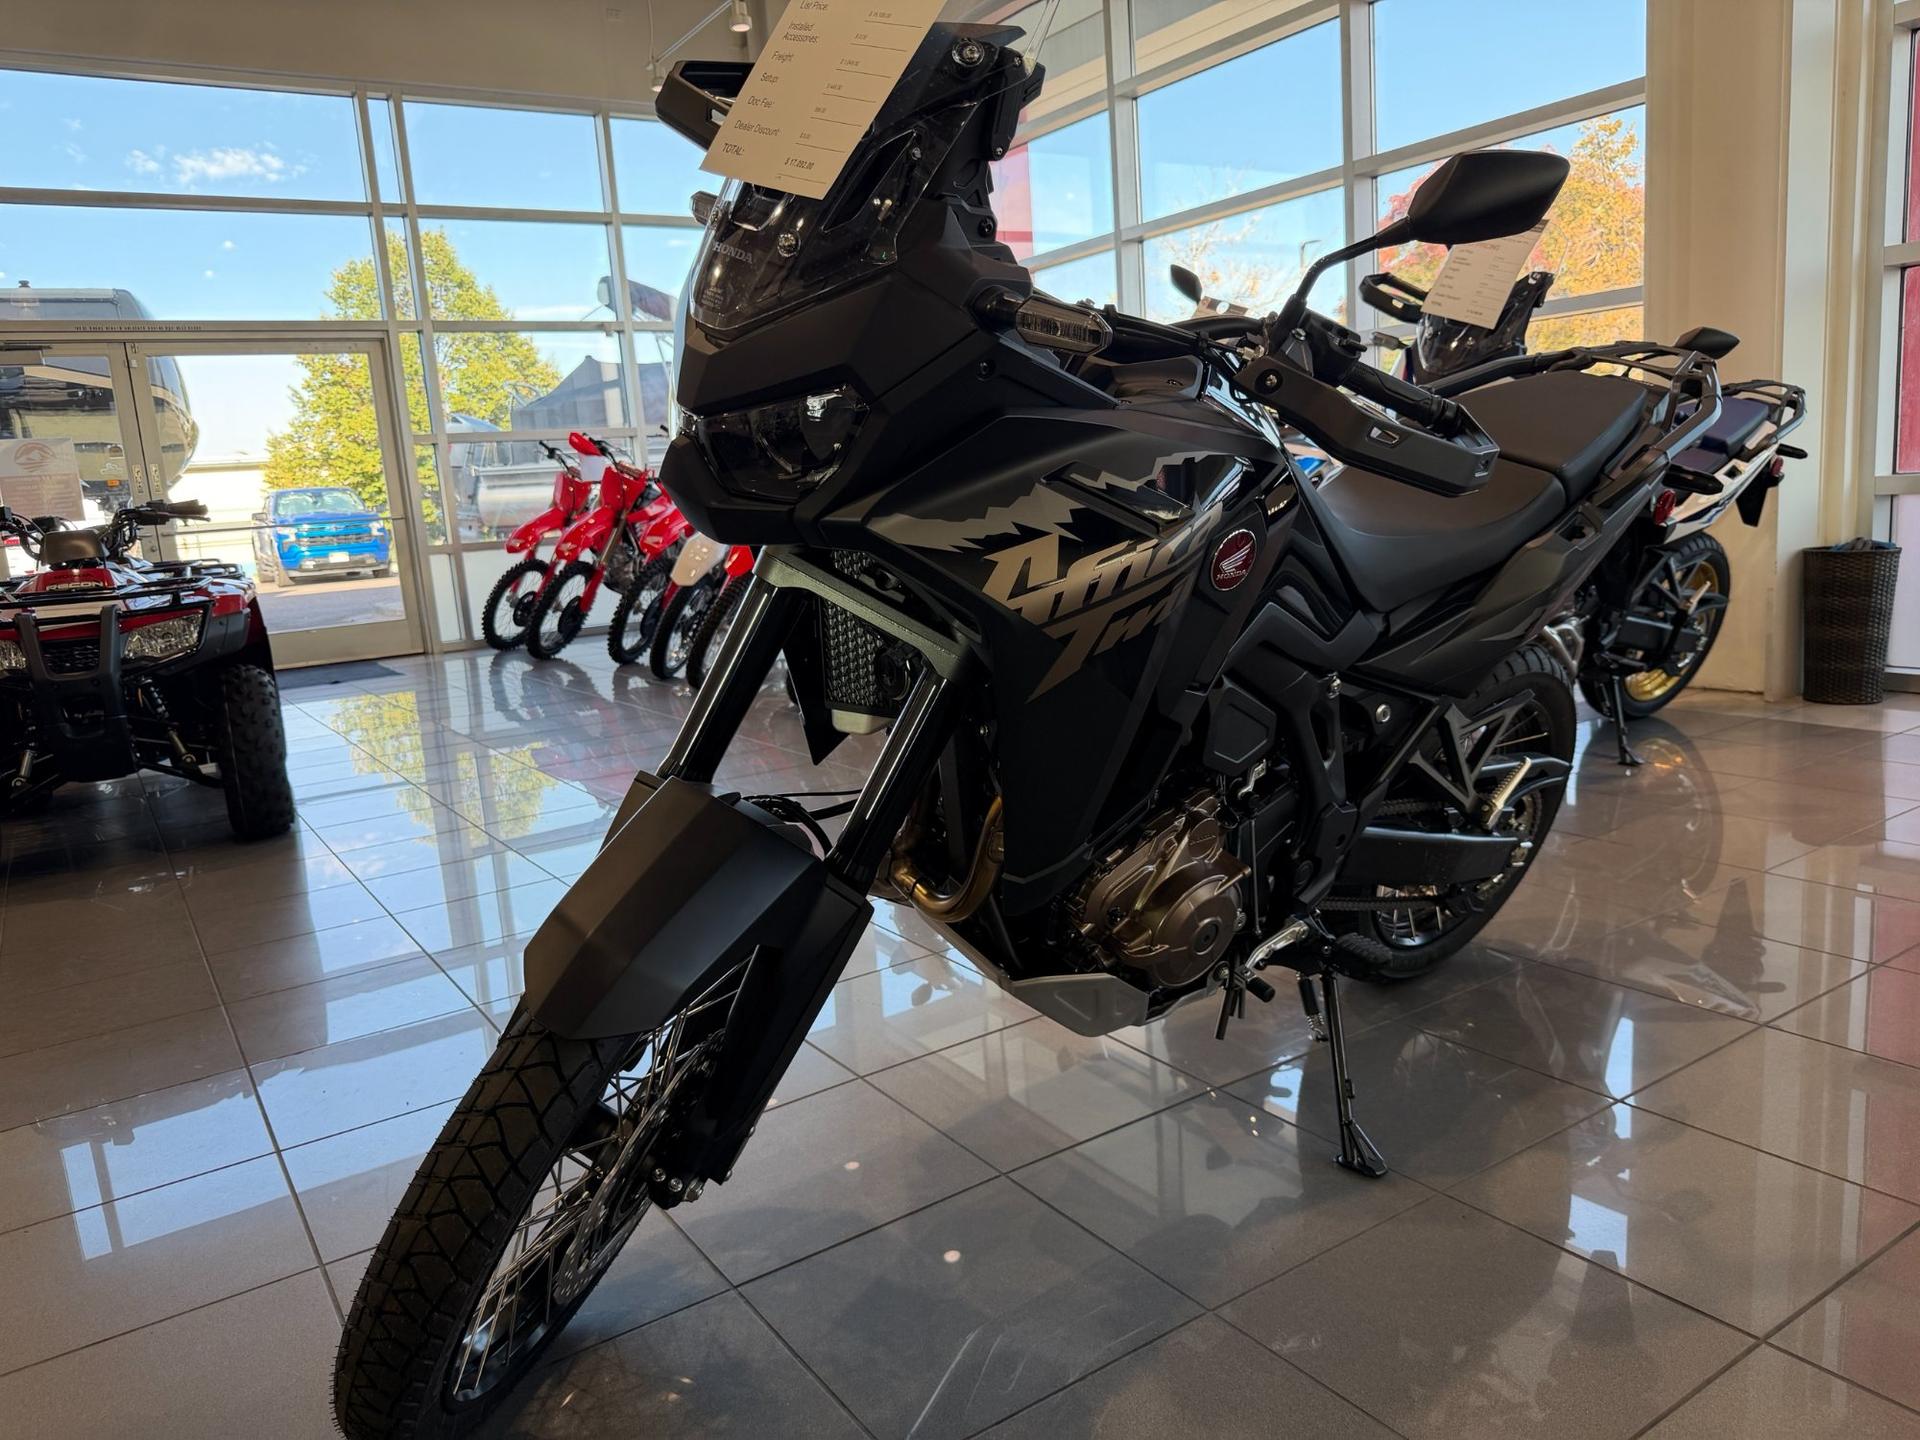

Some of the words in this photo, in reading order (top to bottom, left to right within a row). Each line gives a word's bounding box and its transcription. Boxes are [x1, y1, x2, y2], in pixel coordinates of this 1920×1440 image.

[747, 96, 760, 105] Doc
[712, 241, 753, 265] HONDA
[1215, 569, 1247, 581] HONDA
[46, 580, 104, 592] RECON
